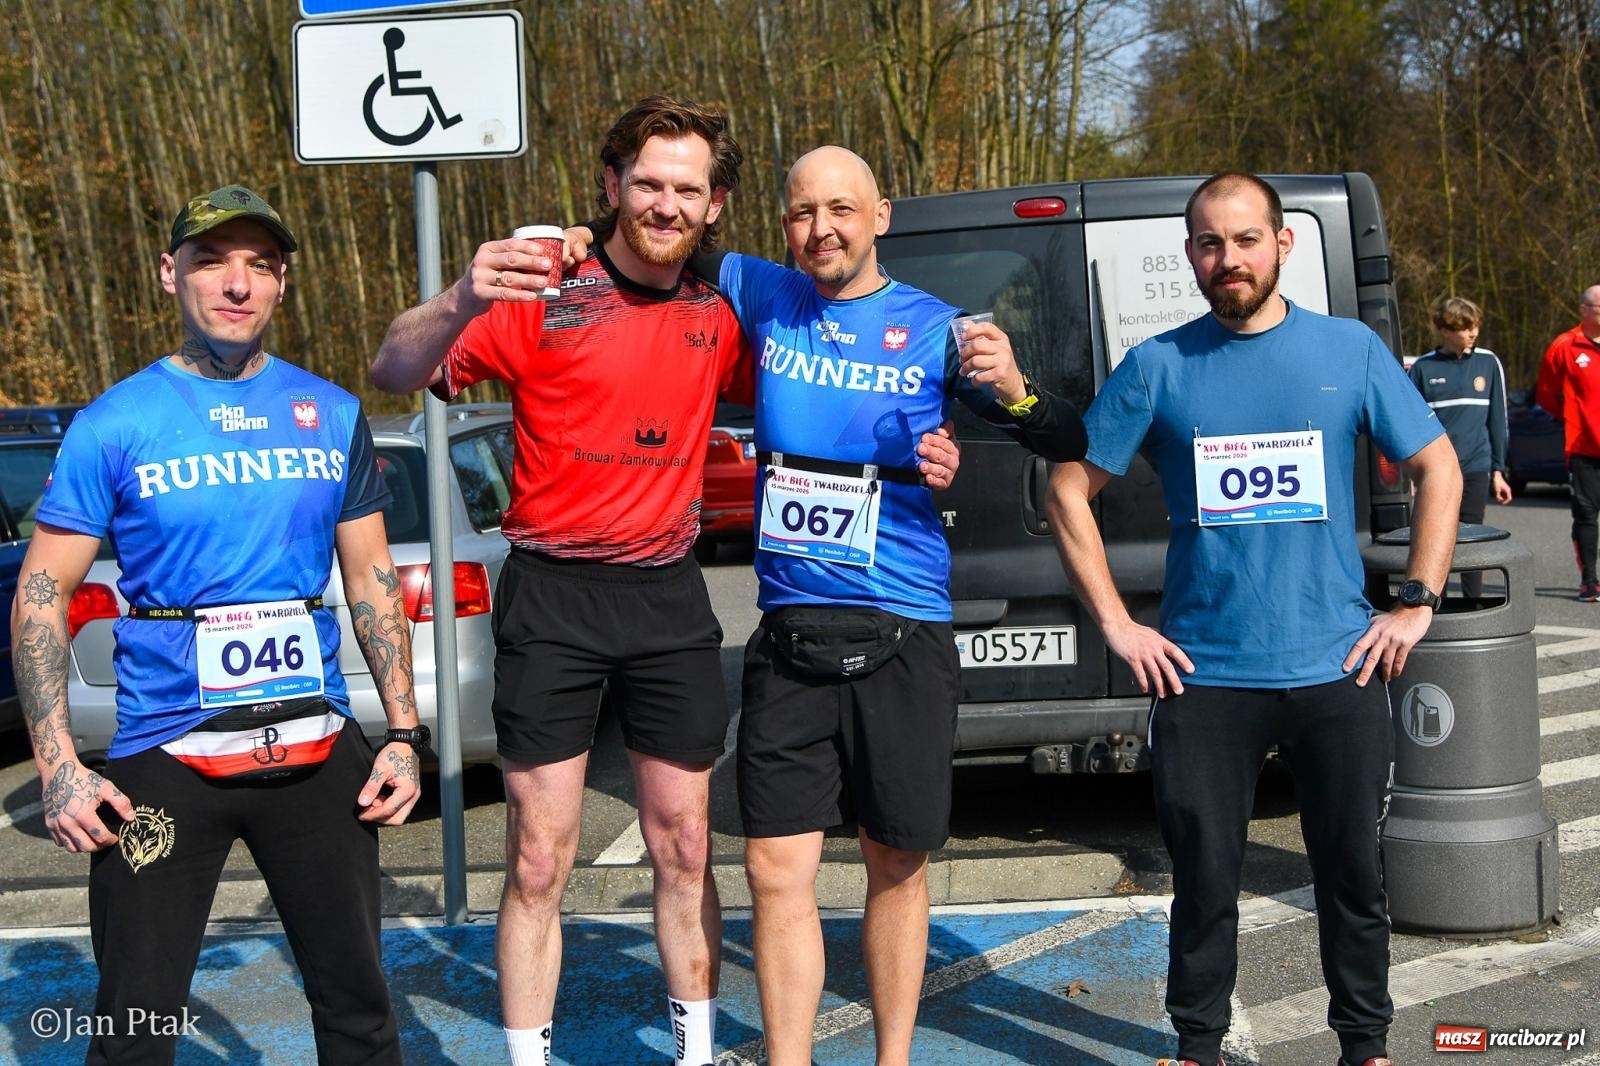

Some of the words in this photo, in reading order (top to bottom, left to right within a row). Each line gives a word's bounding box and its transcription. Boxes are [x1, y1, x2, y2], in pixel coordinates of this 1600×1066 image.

[1142, 254, 1180, 273] 883
[1144, 281, 1182, 300] 515
[760, 335, 926, 396] RUNNERS
[574, 447, 615, 464] Browar
[1203, 443, 1220, 453] XIV
[1224, 441, 1248, 453] BIEG
[1251, 438, 1313, 450] TWARDZIELA
[134, 447, 346, 499] RUNNERS
[771, 473, 787, 484] XIV
[789, 476, 811, 488] BIEG
[813, 479, 872, 495] TWARDZIELA
[1220, 464, 1300, 501] 095
[781, 500, 855, 539] 067
[204, 614, 222, 625] XIV
[226, 611, 253, 623] BIEG
[256, 606, 307, 619] TWARDZIELA
[221, 634, 304, 677] 046
[971, 631, 1068, 663] 0557T
[674, 1018, 686, 1061] LOTTO
